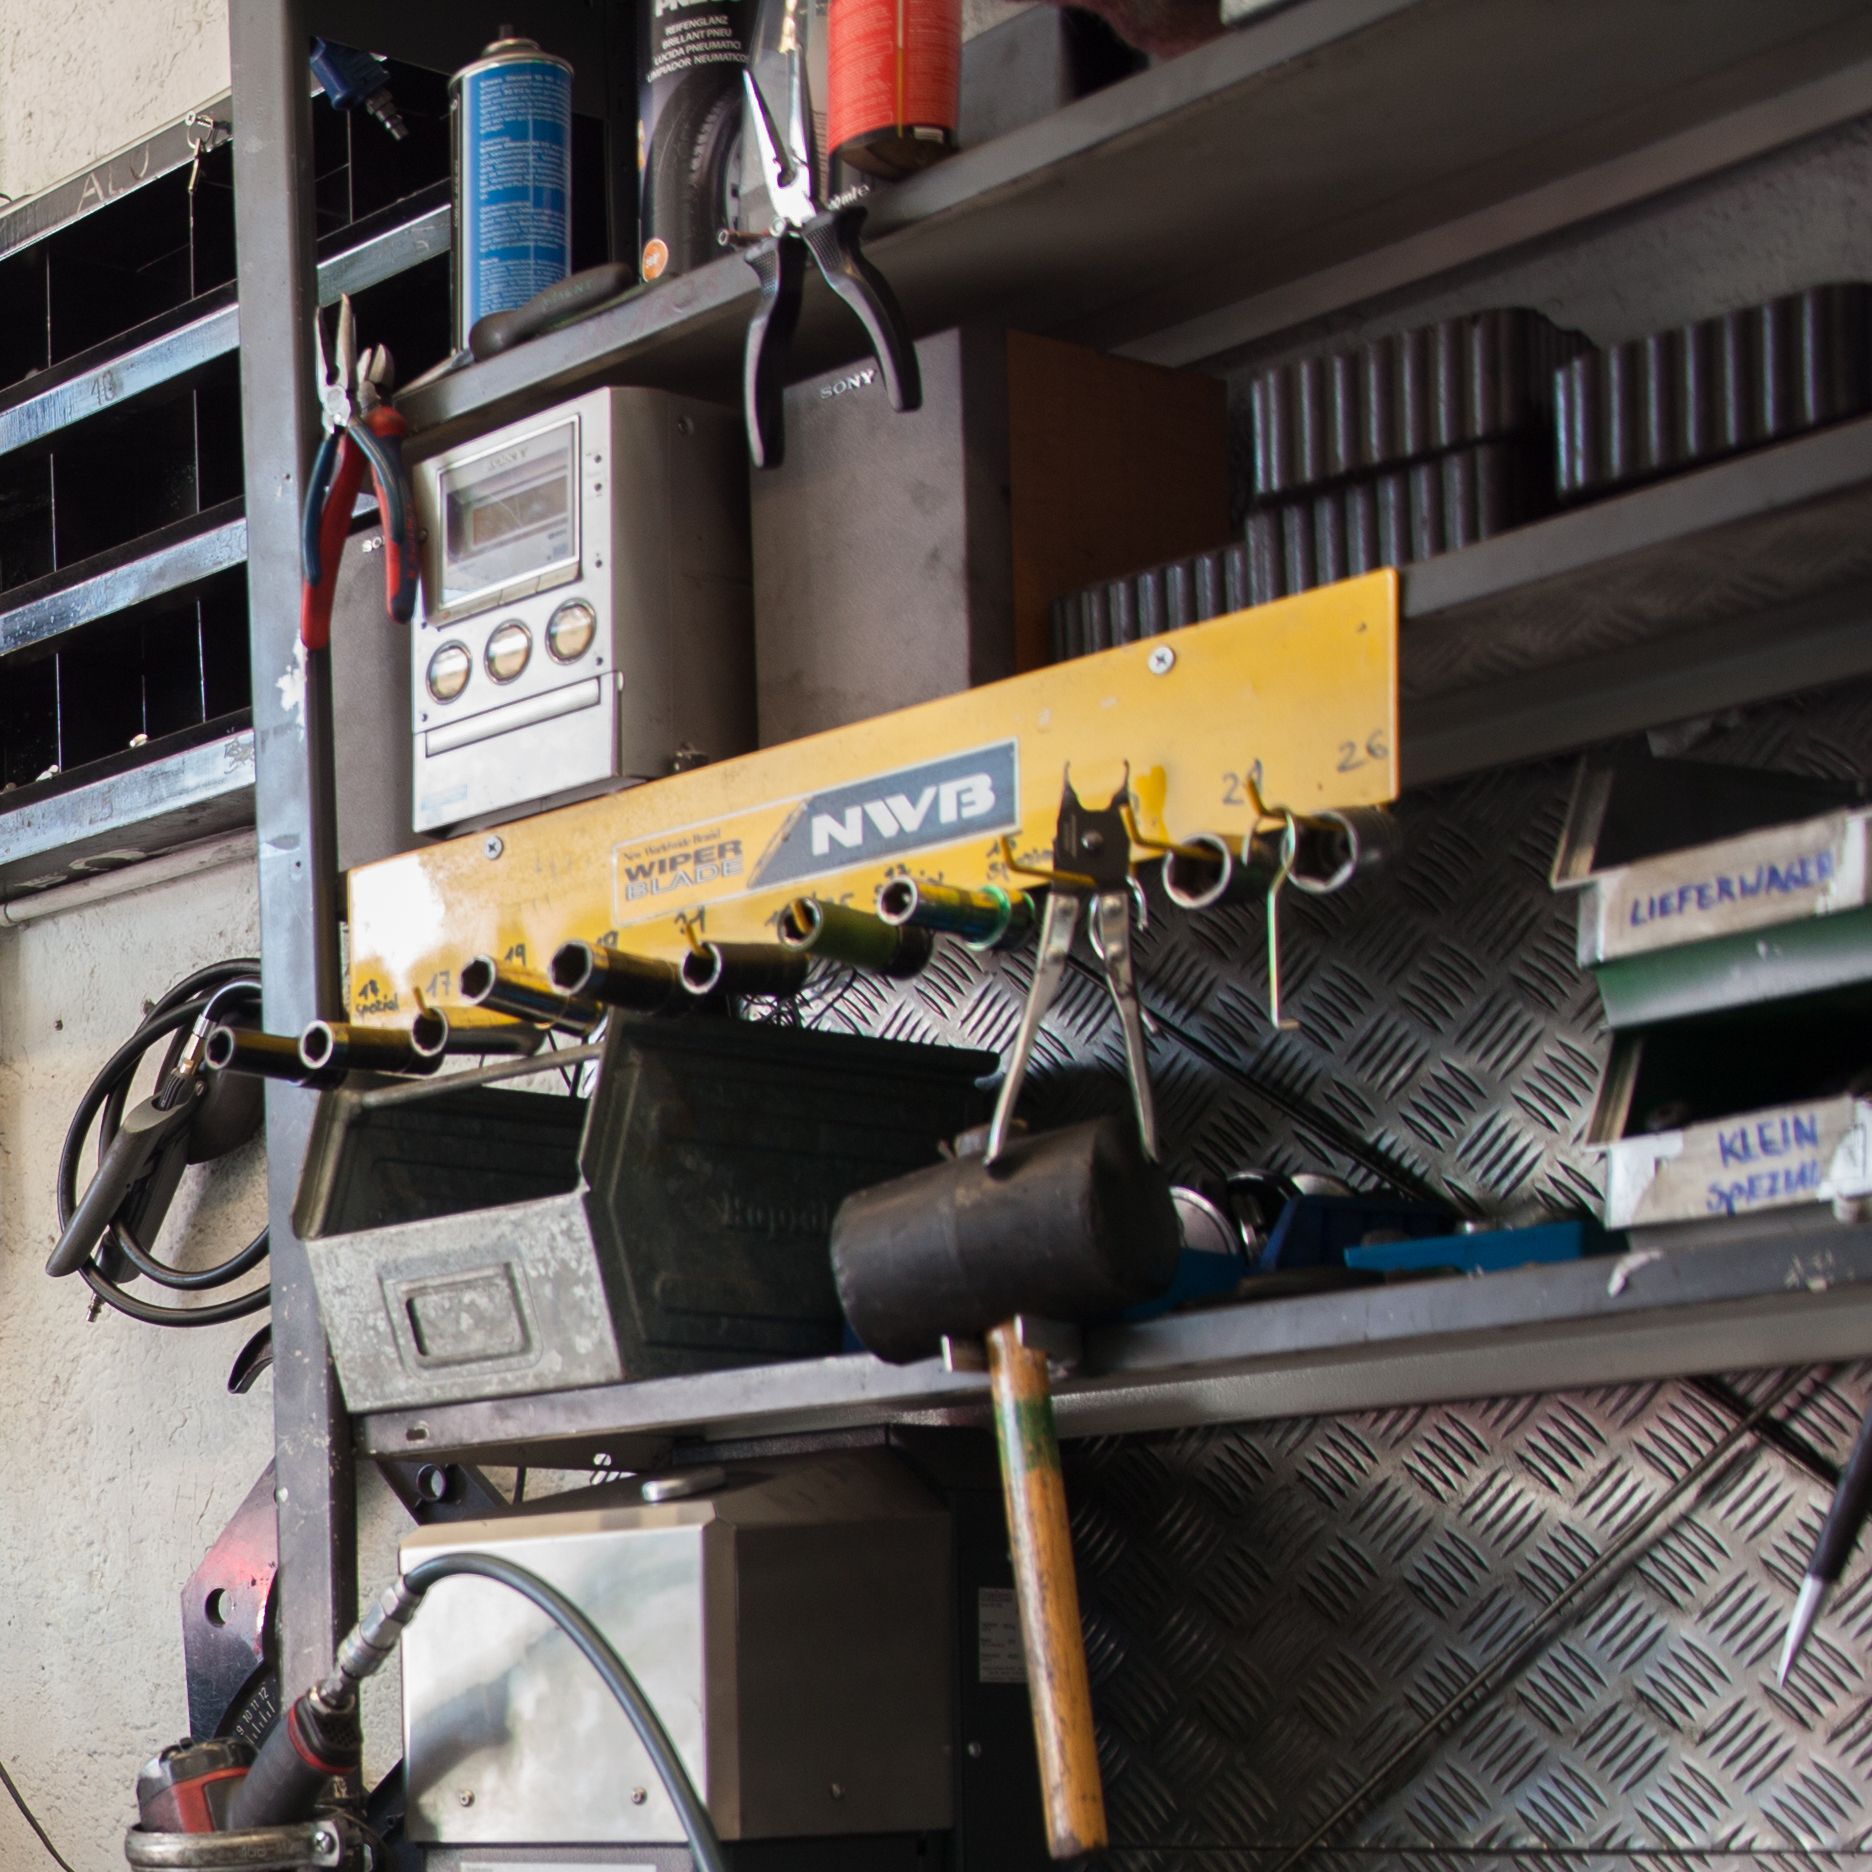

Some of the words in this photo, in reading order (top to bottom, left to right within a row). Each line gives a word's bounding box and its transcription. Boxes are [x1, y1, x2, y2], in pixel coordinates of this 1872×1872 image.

[662, 30, 705, 50] BRILLANT
[706, 28, 732, 38] PNEU
[665, 15, 729, 36] REIFENGLANZ
[77, 142, 150, 214] ALU
[820, 368, 875, 399] SONY
[362, 534, 385, 553] SO
[1337, 730, 1388, 773] 26
[810, 771, 997, 857] NWB
[623, 838, 744, 883] WIPER
[624, 854, 745, 902] BLADE
[425, 969, 452, 998] 17
[1717, 1112, 1820, 1169] KLEIN
[250, 1699, 260, 1711] 11
[258, 1687, 269, 1701] 12
[235, 1724, 245, 1736] 9
[242, 1709, 253, 1724] 10
